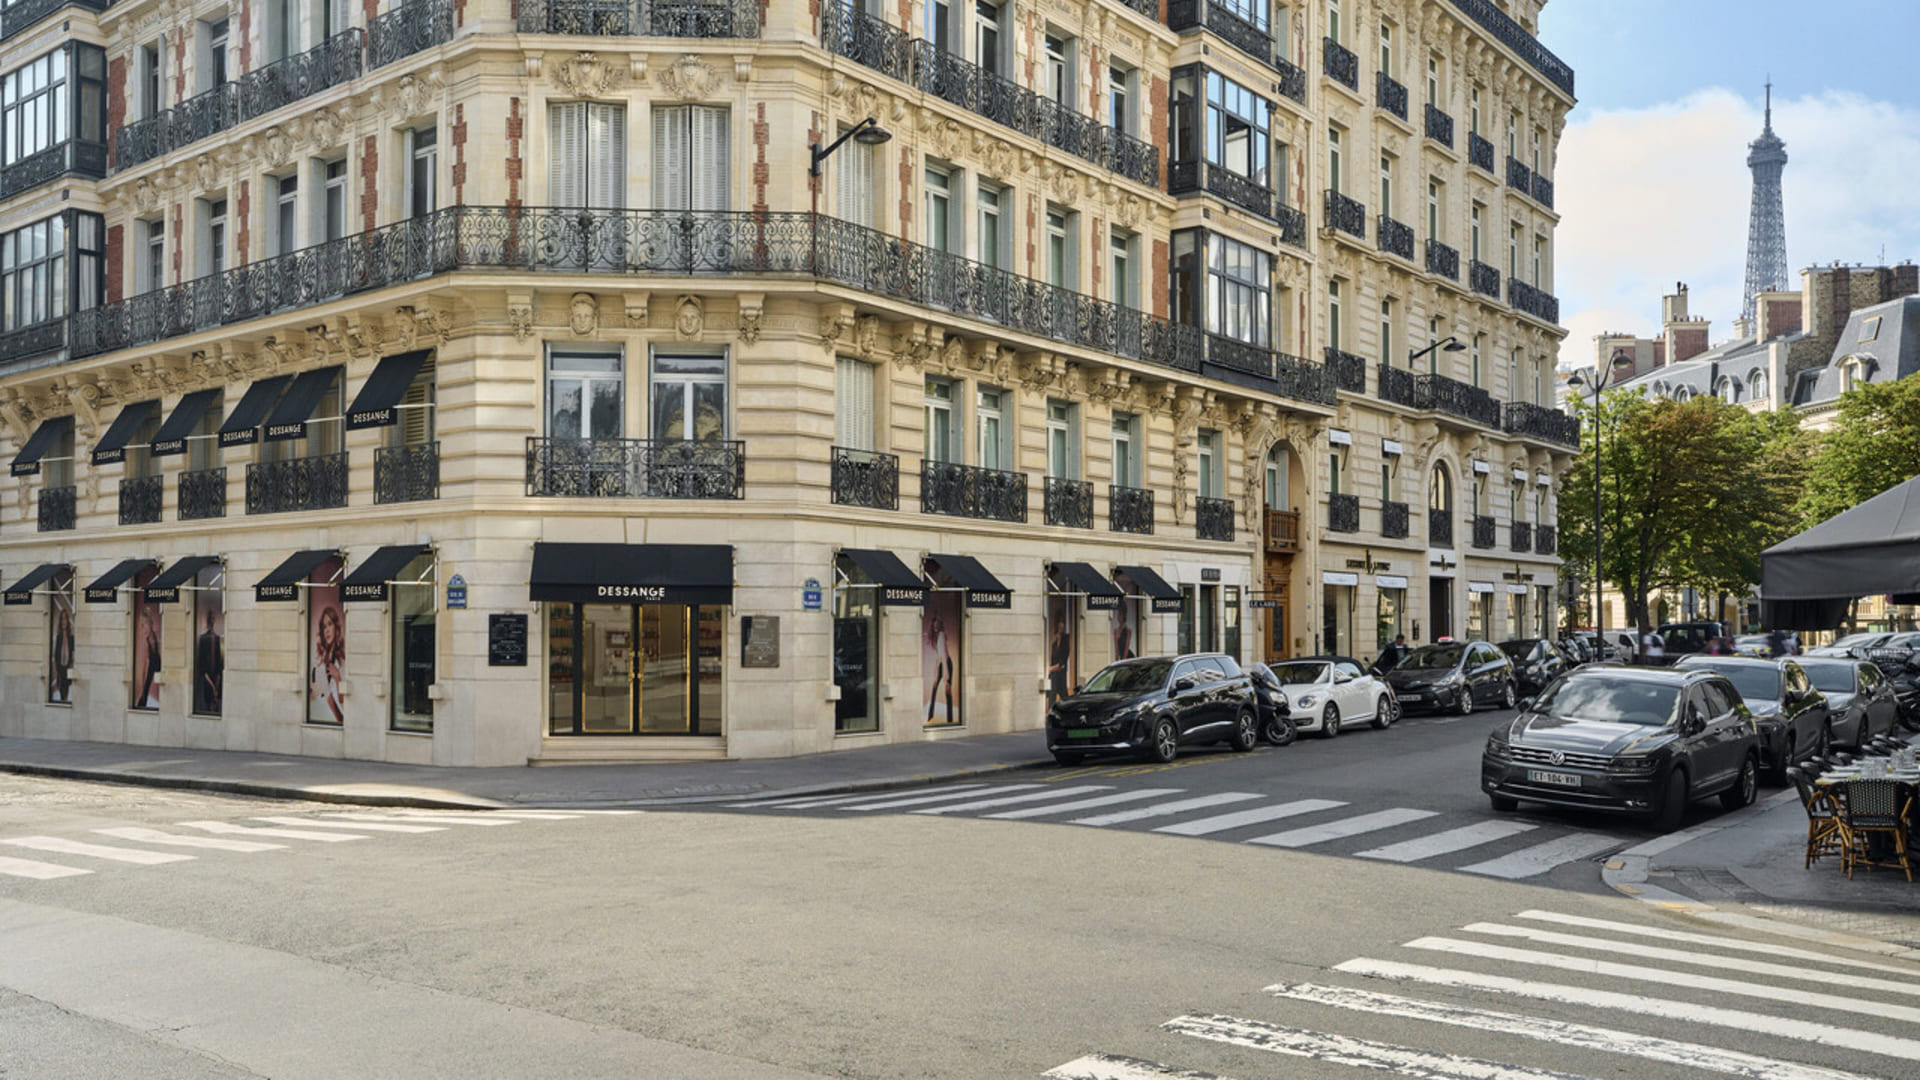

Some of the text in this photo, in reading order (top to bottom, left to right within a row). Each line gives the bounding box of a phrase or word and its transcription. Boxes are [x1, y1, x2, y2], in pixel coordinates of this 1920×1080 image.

[353, 409, 390, 423] DESSANGE
[269, 424, 301, 436] DESSANGE
[223, 430, 253, 442] DESSANGE
[260, 586, 293, 596] DESSANGE
[345, 585, 382, 596] DESSANGE
[598, 586, 665, 597] DESSANGE
[886, 589, 923, 600] DESSANGE
[971, 592, 1006, 603] DESSANGE
